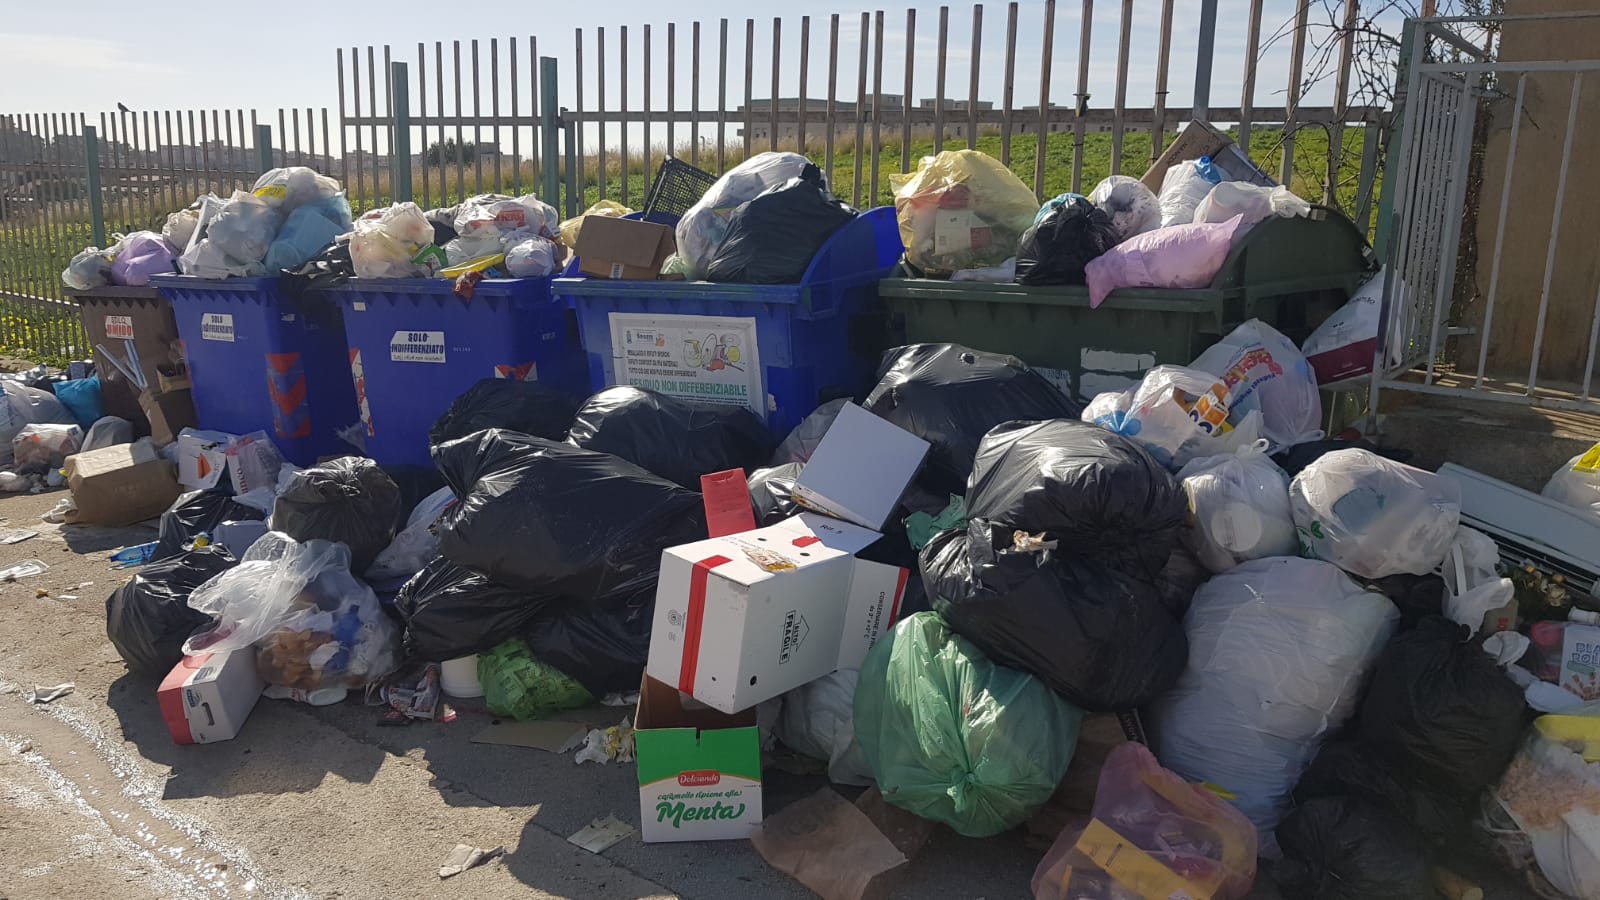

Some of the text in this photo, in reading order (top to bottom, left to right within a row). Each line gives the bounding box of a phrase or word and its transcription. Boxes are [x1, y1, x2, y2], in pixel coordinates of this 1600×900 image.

[107, 324, 132, 336] UMIDO
[407, 332, 428, 342] SOLO
[391, 343, 444, 354] INDIFFERENZIATO
[629, 378, 748, 396] RESIDUO NON DIFFERENZIABILE
[875, 591, 885, 630] CONSERVARE
[781, 613, 794, 661] FRAGILE
[792, 624, 800, 644] ALTO
[657, 789, 742, 800] caramelle ripiene alla
[655, 801, 746, 829] Menta
